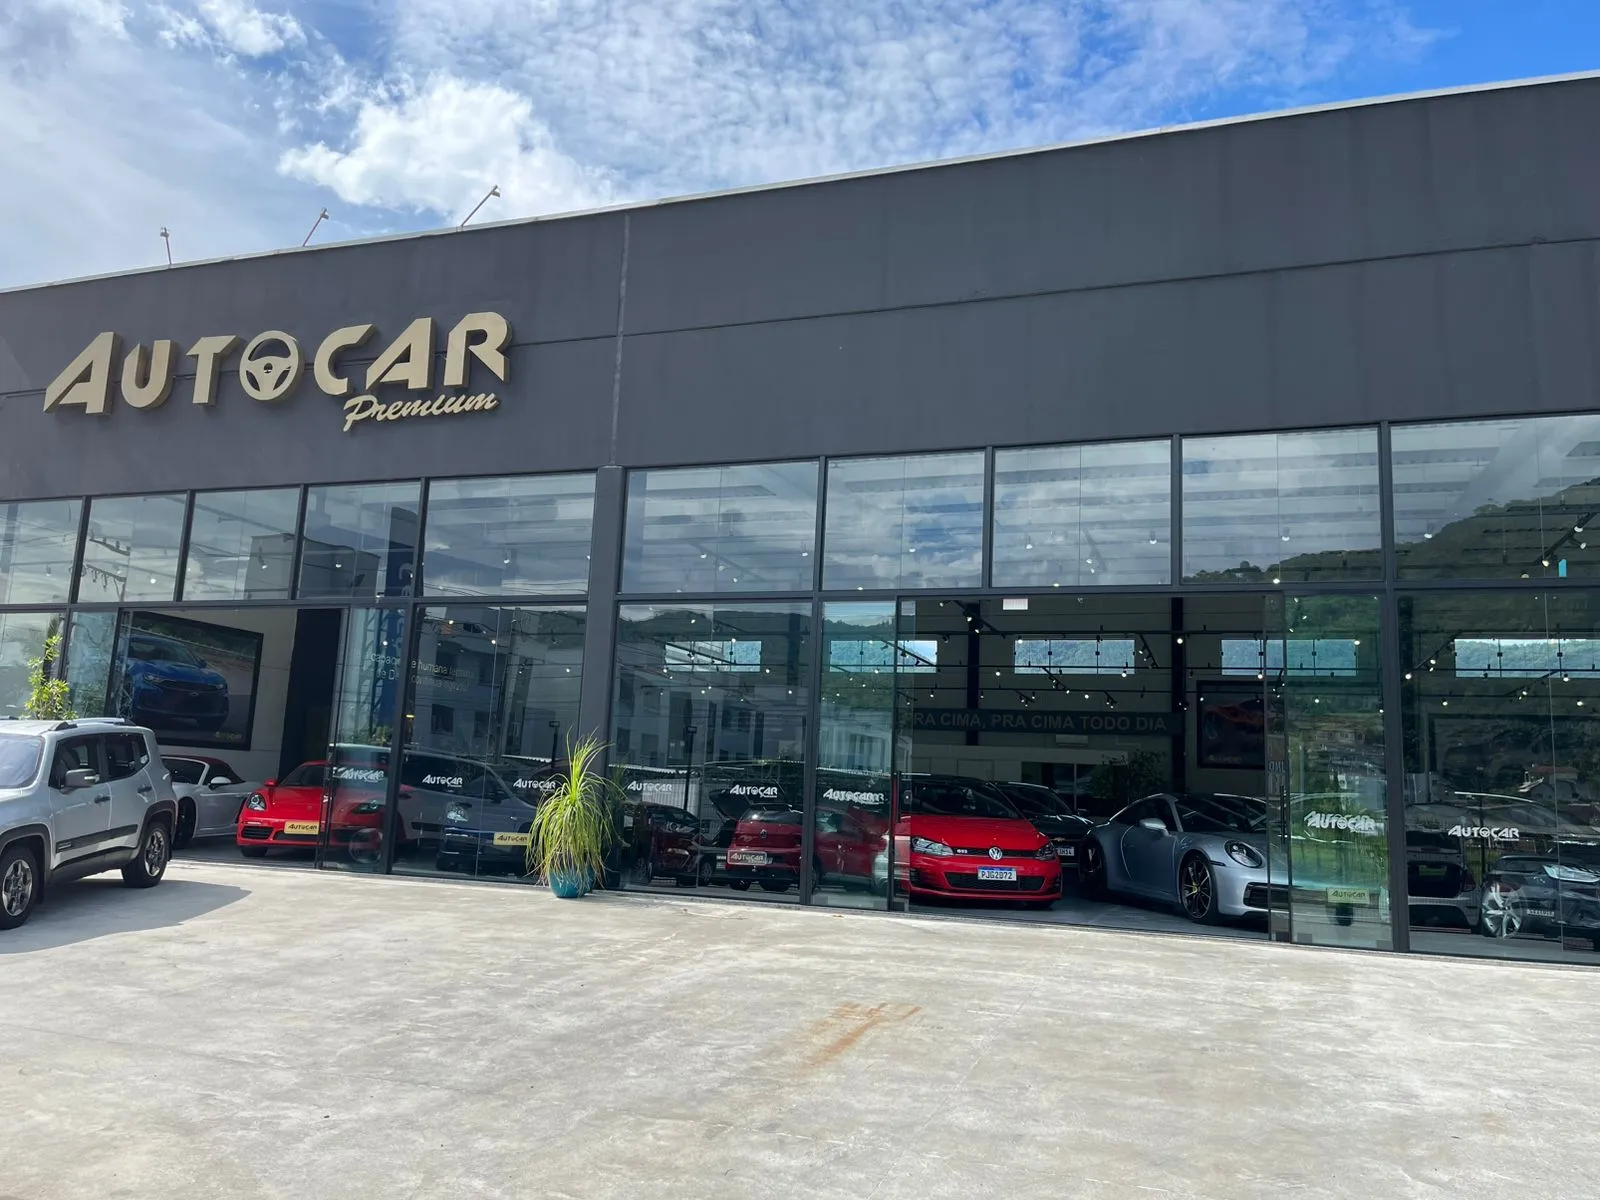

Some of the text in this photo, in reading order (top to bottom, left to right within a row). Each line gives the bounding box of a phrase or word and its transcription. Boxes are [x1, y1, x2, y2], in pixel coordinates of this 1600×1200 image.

[43, 311, 510, 415] AUTOCAR
[343, 392, 500, 431] Premium
[991, 715, 1027, 728] PRA
[1031, 715, 1075, 729] CIMA
[1080, 716, 1130, 730] TODO
[1136, 717, 1167, 731] DIA
[422, 774, 463, 785] AUTOCAR
[627, 780, 673, 792] AUTOCAR
[729, 784, 778, 796] AUTOCAR
[1448, 825, 1520, 838] AUTOCAR
